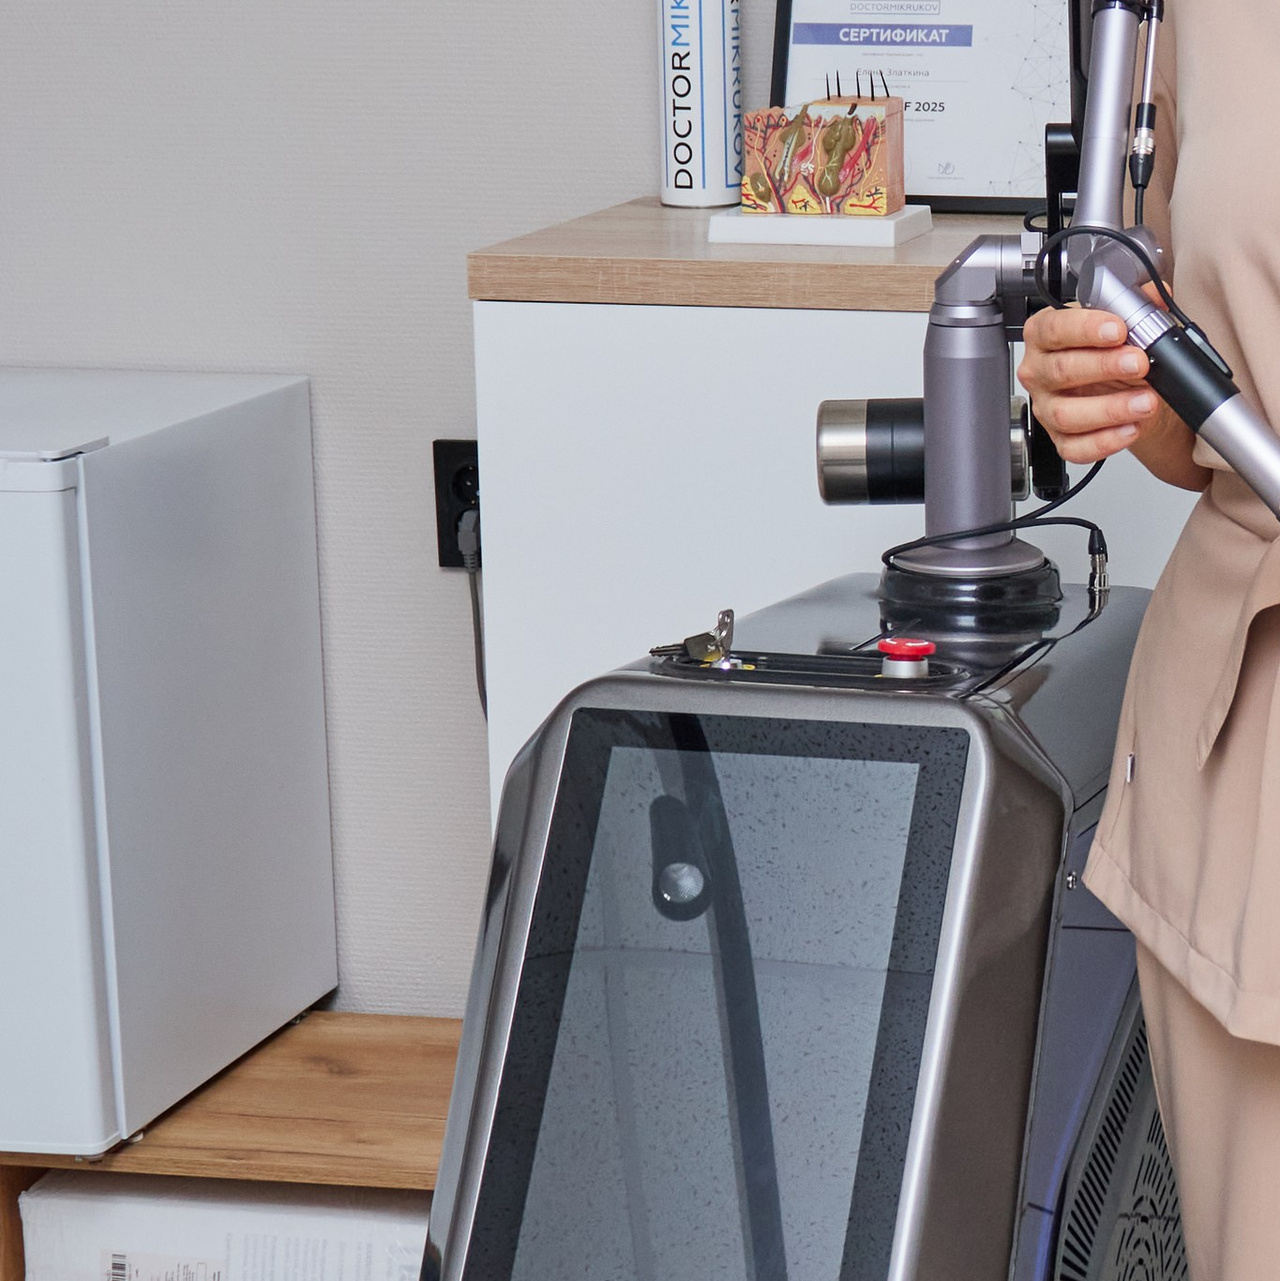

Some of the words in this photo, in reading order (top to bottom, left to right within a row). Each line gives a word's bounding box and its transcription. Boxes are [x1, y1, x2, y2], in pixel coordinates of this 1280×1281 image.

[850, 2, 939, 12] DOCTORMIKRUKOV
[838, 27, 950, 43] СЕРТИФИКАТ
[886, 68, 930, 78] Златкина
[915, 101, 945, 112] 2025
